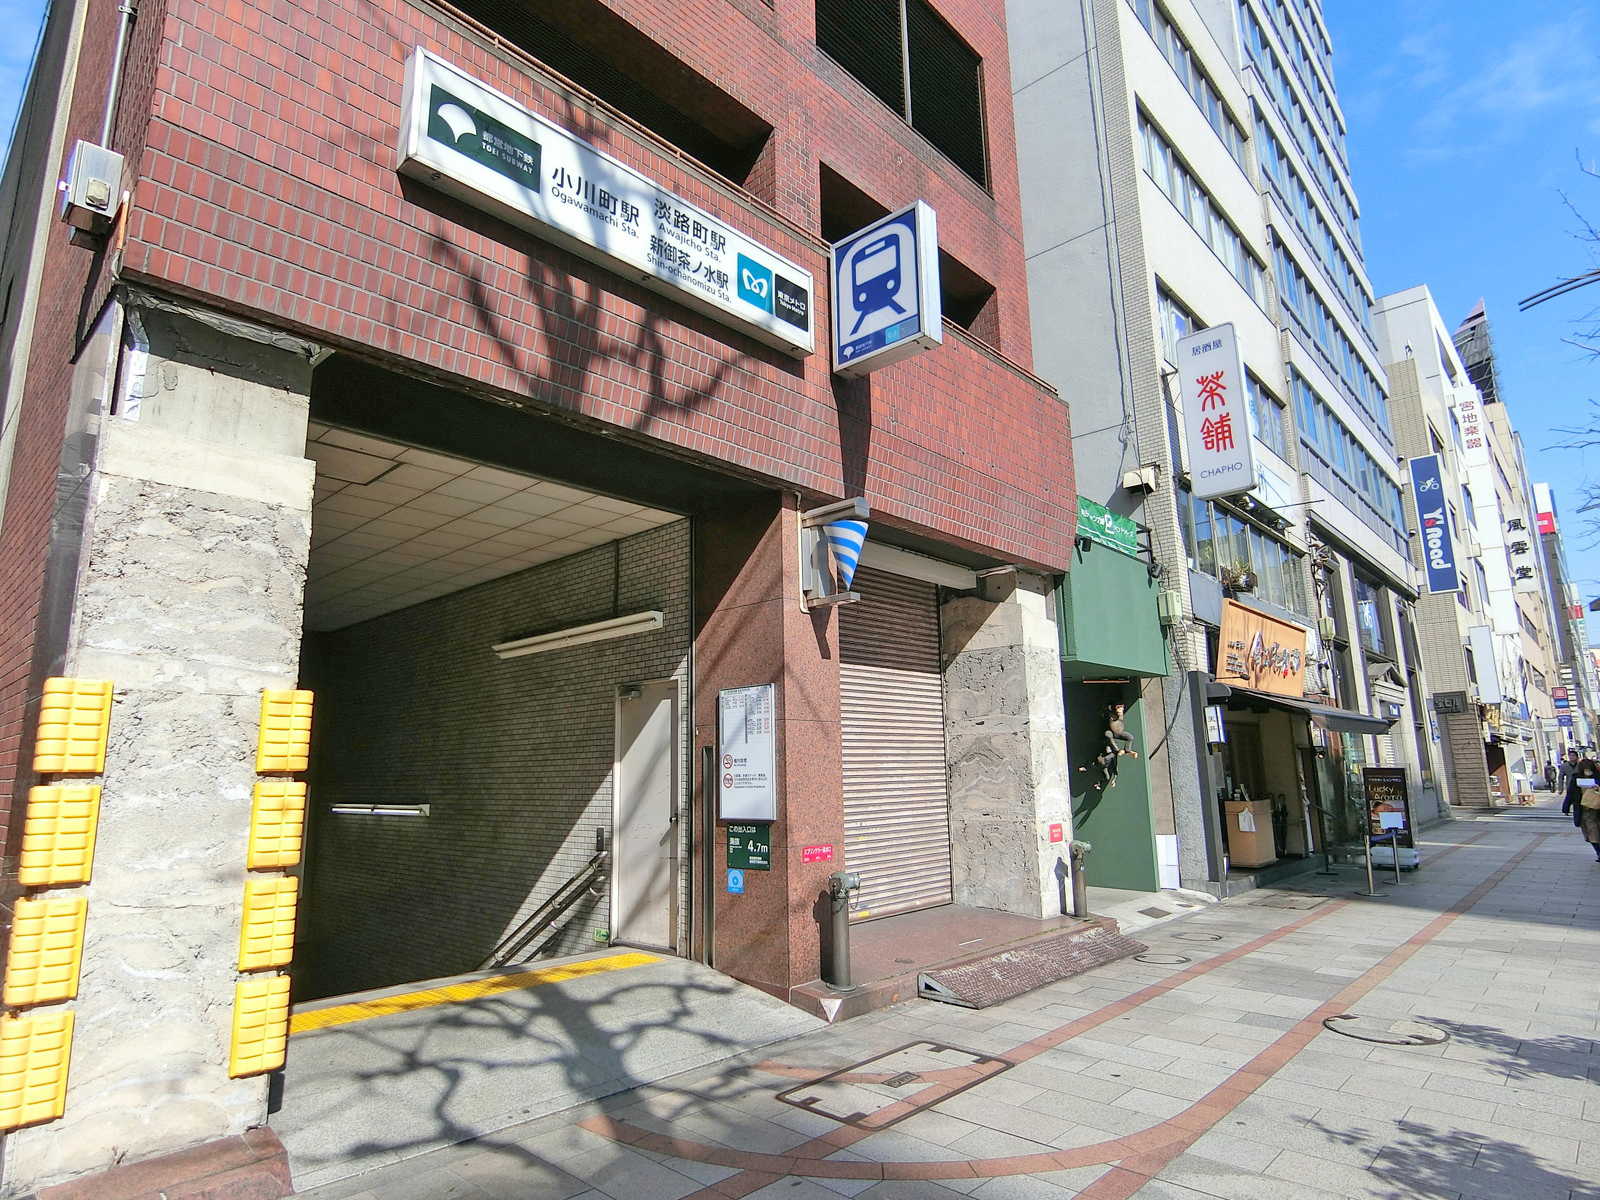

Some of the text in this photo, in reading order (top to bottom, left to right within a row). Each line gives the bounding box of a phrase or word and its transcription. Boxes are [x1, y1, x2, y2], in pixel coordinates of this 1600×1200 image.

[482, 131, 534, 165] 都営地下鉄
[482, 142, 533, 174] TOEI SUBWAY
[551, 186, 639, 239] Ogawamachi Sta.
[552, 167, 639, 227] 小川町駅
[654, 198, 726, 255] 淡路町駅
[659, 223, 721, 263] Awajicho Sta.
[647, 253, 732, 303] Shin-ochanomizu Sta.
[650, 234, 729, 291] 新御茶ノ水駅
[777, 290, 806, 311] 東京メトロ
[791, 304, 805, 316] Metro
[1191, 339, 1223, 356] 居酒屋
[1459, 401, 1482, 449] 宮地楽器
[1200, 462, 1243, 479] CHAPHO
[1507, 518, 1534, 581] 風雲堂
[1368, 784, 1394, 794] Lucky
[729, 825, 756, 833] この出入口は
[747, 839, 768, 853] 4.7m
